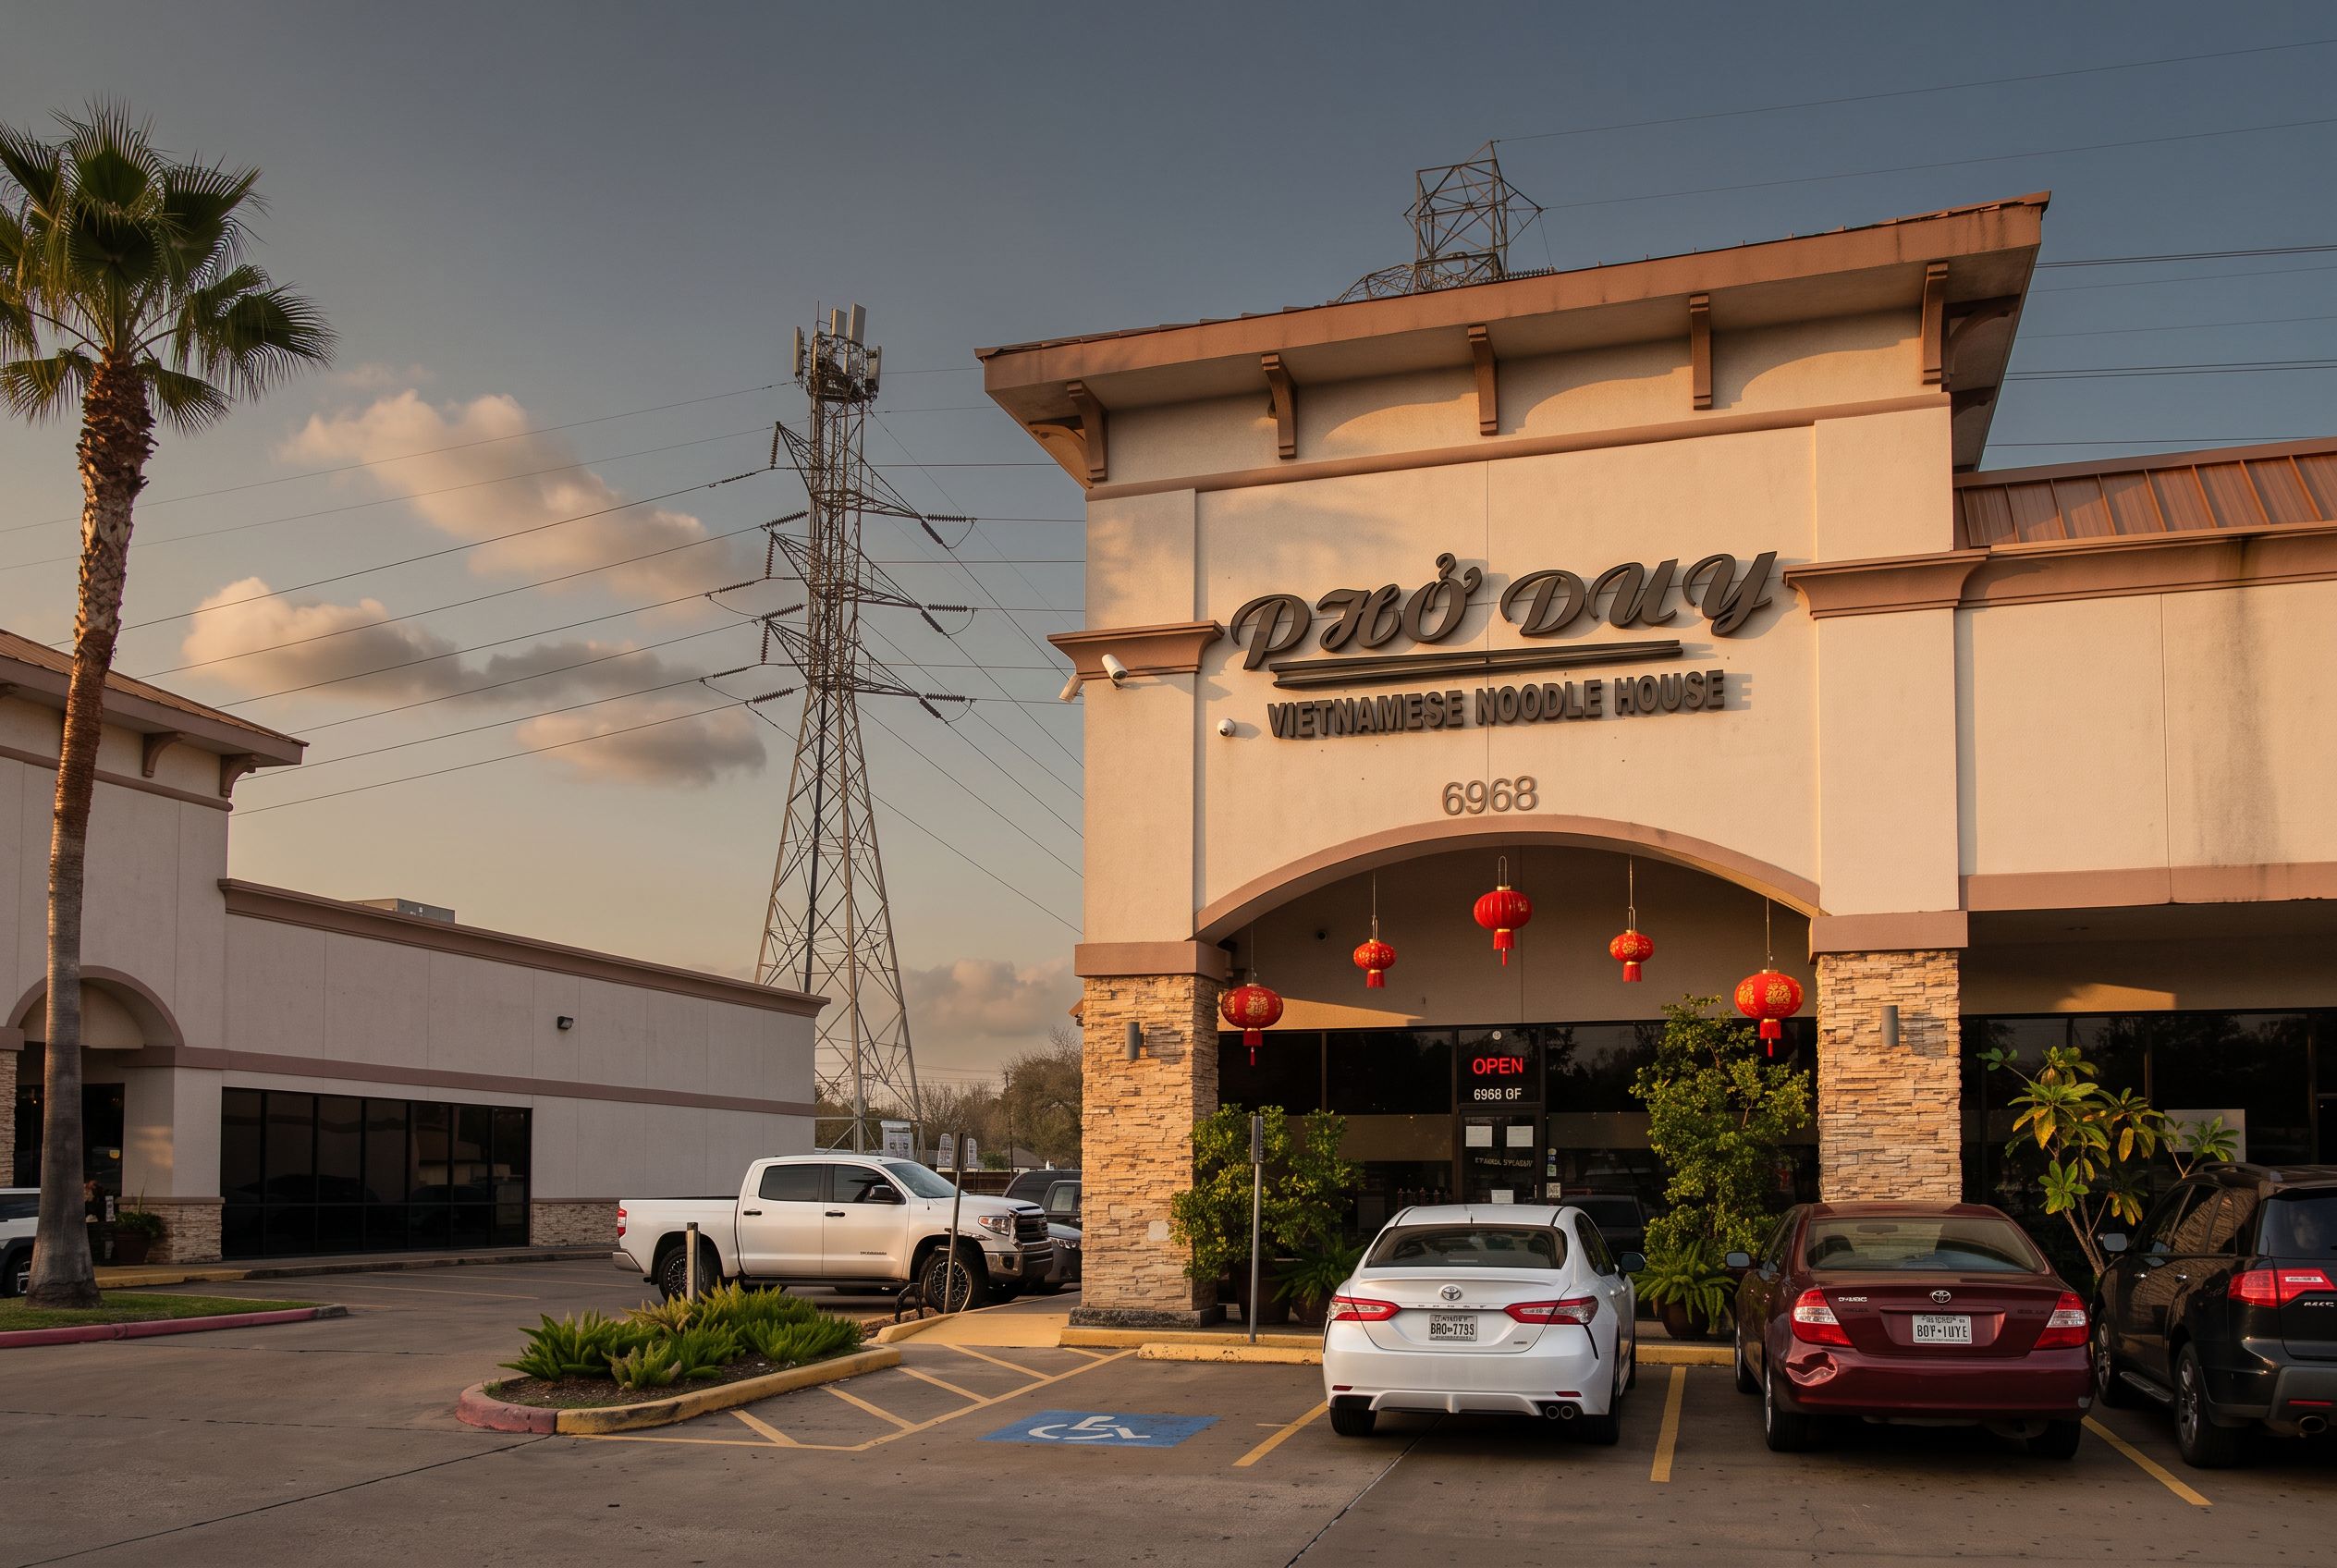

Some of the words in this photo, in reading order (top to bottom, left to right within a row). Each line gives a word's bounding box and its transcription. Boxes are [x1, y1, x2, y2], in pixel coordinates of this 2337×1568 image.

[1499, 551, 1778, 637] DUY
[1267, 690, 1464, 739] VIETNAMESE
[1475, 680, 1602, 726] NOODLE
[1615, 669, 1725, 715] HOUSE
[1442, 776, 1537, 815] 6968
[1473, 1058, 1523, 1074] OPEN
[1474, 1088, 1502, 1100] 6968
